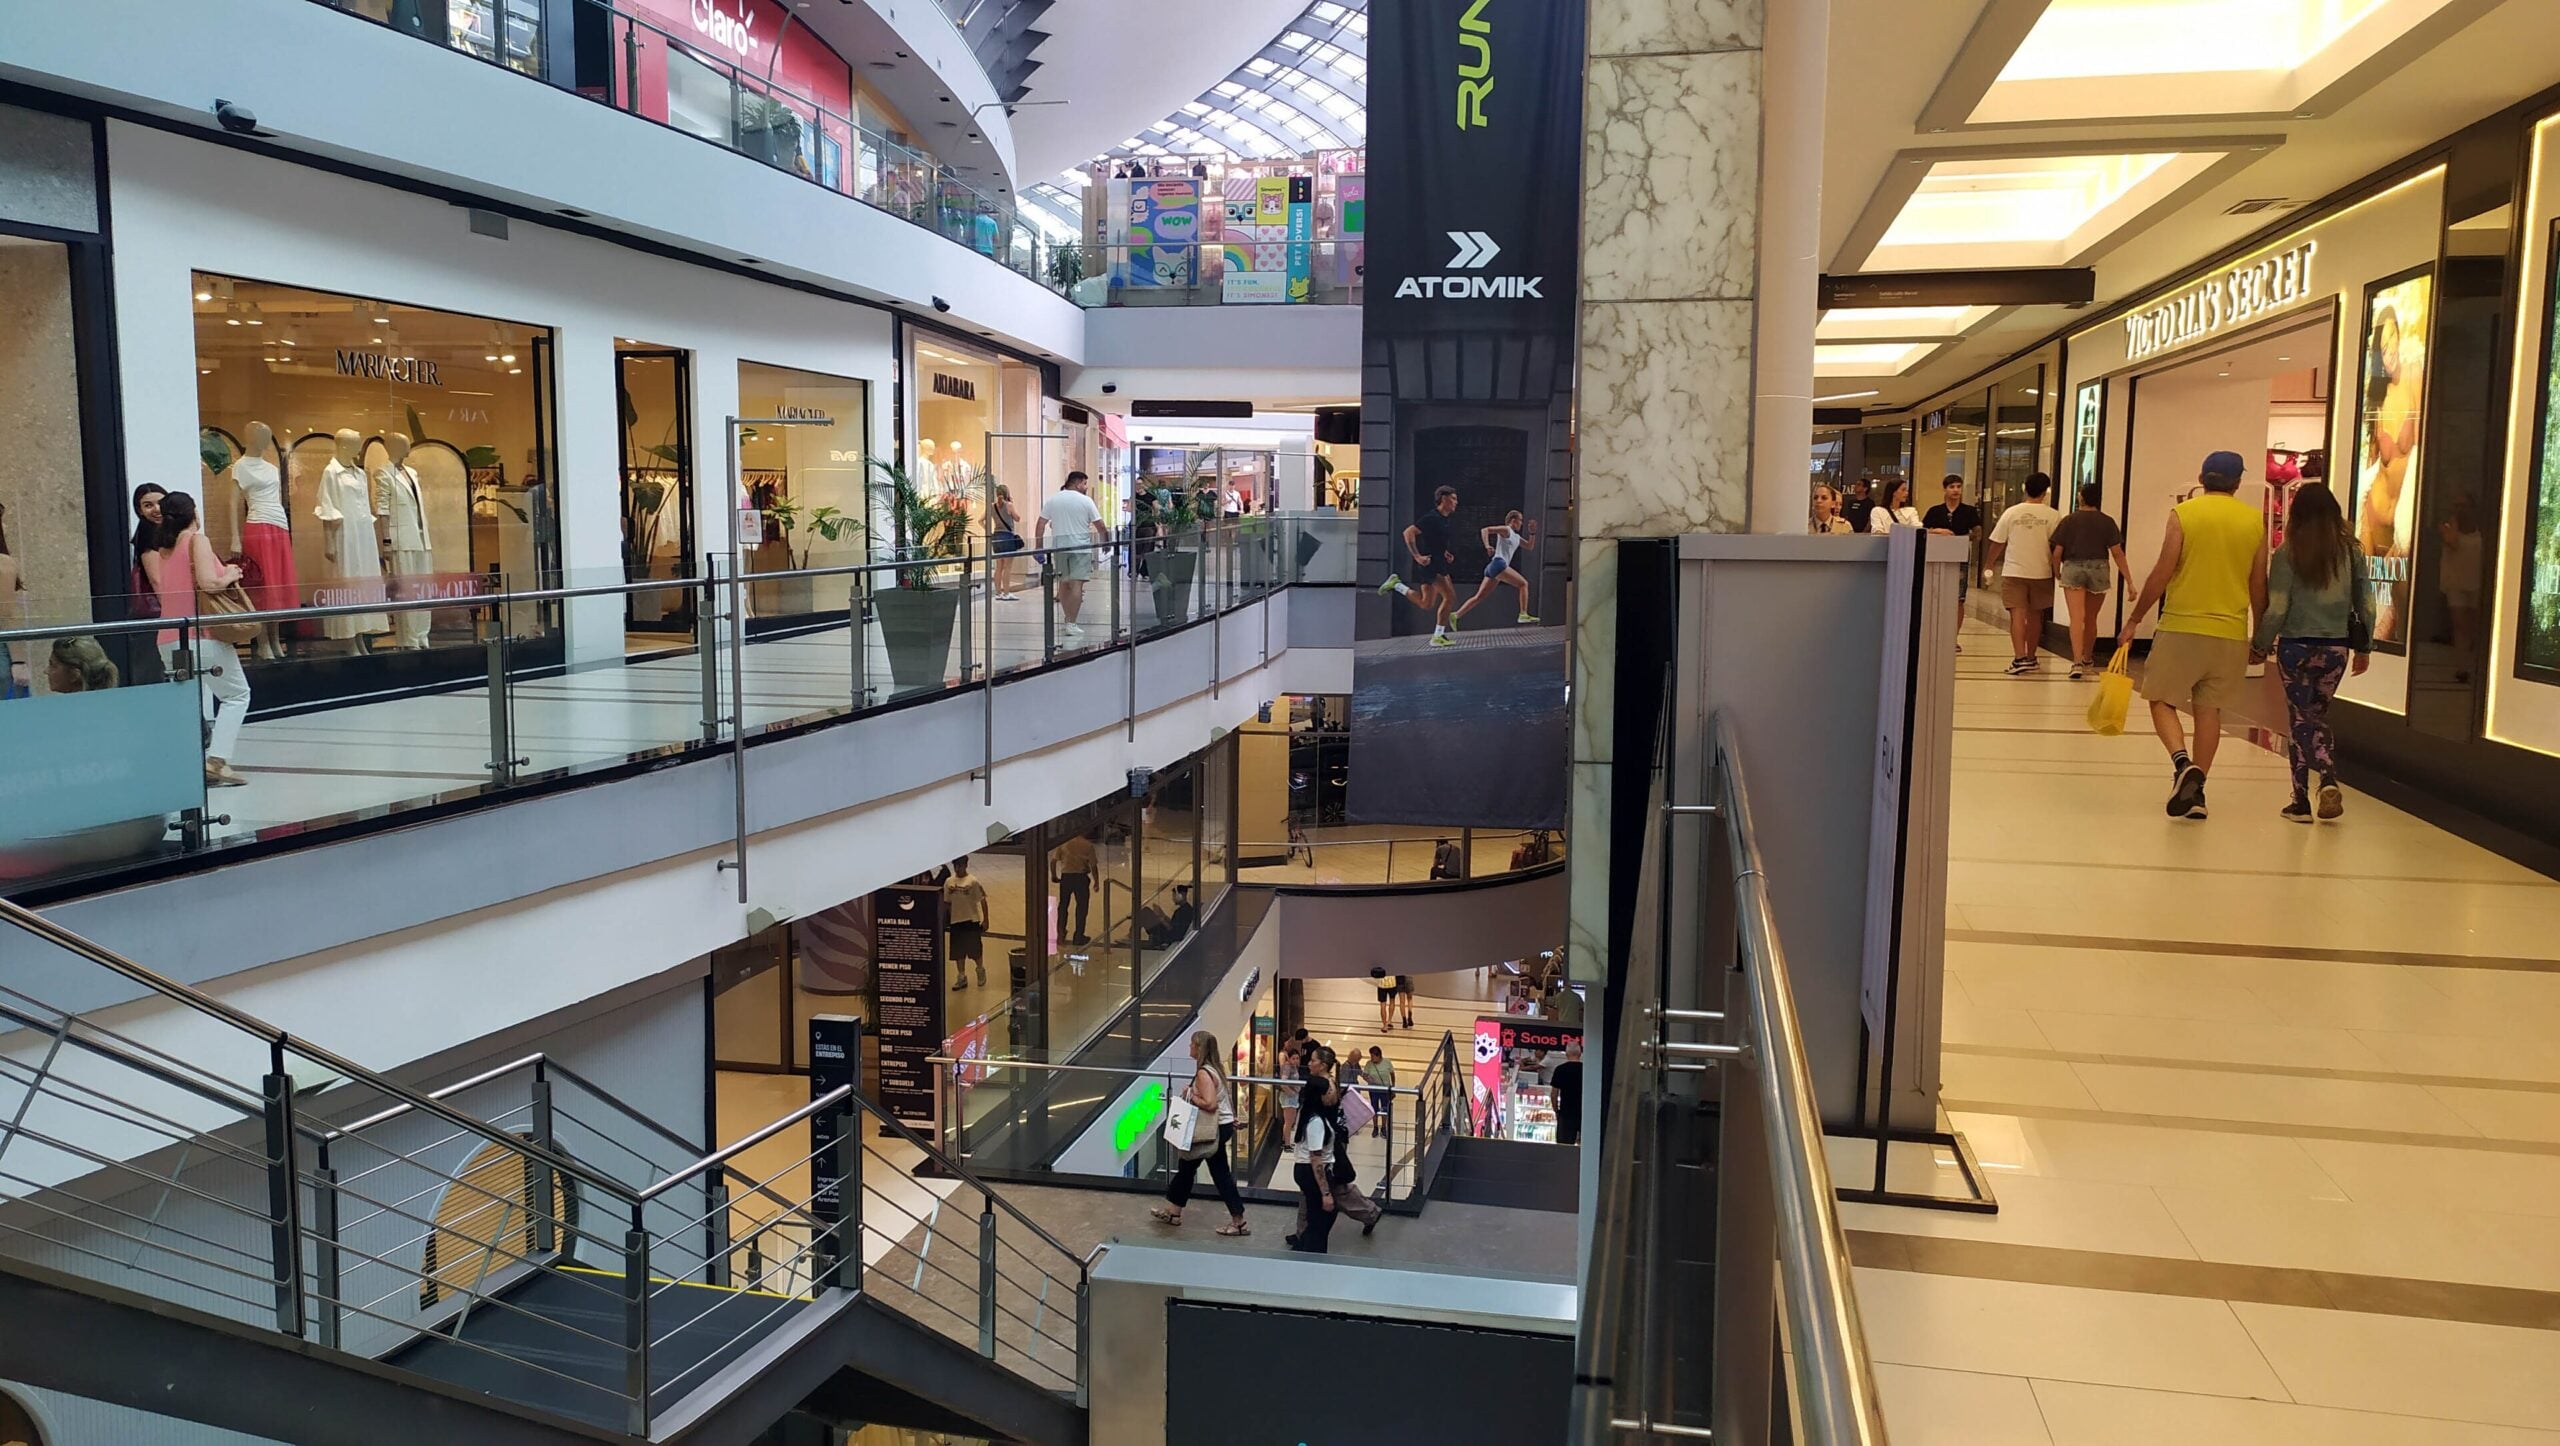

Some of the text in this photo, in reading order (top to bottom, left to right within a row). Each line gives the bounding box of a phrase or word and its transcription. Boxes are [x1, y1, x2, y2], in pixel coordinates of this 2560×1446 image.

[690, 0, 748, 56] Claro
[1162, 216, 1192, 226] WOW
[1394, 276, 1544, 298] ATOMIK
[2124, 239, 2317, 360] VICTORIA'S SECRET
[880, 1028, 913, 1037] TERCER PISO
[1521, 1032, 1557, 1045] Saos
[881, 1060, 908, 1068] ENTREPISO
